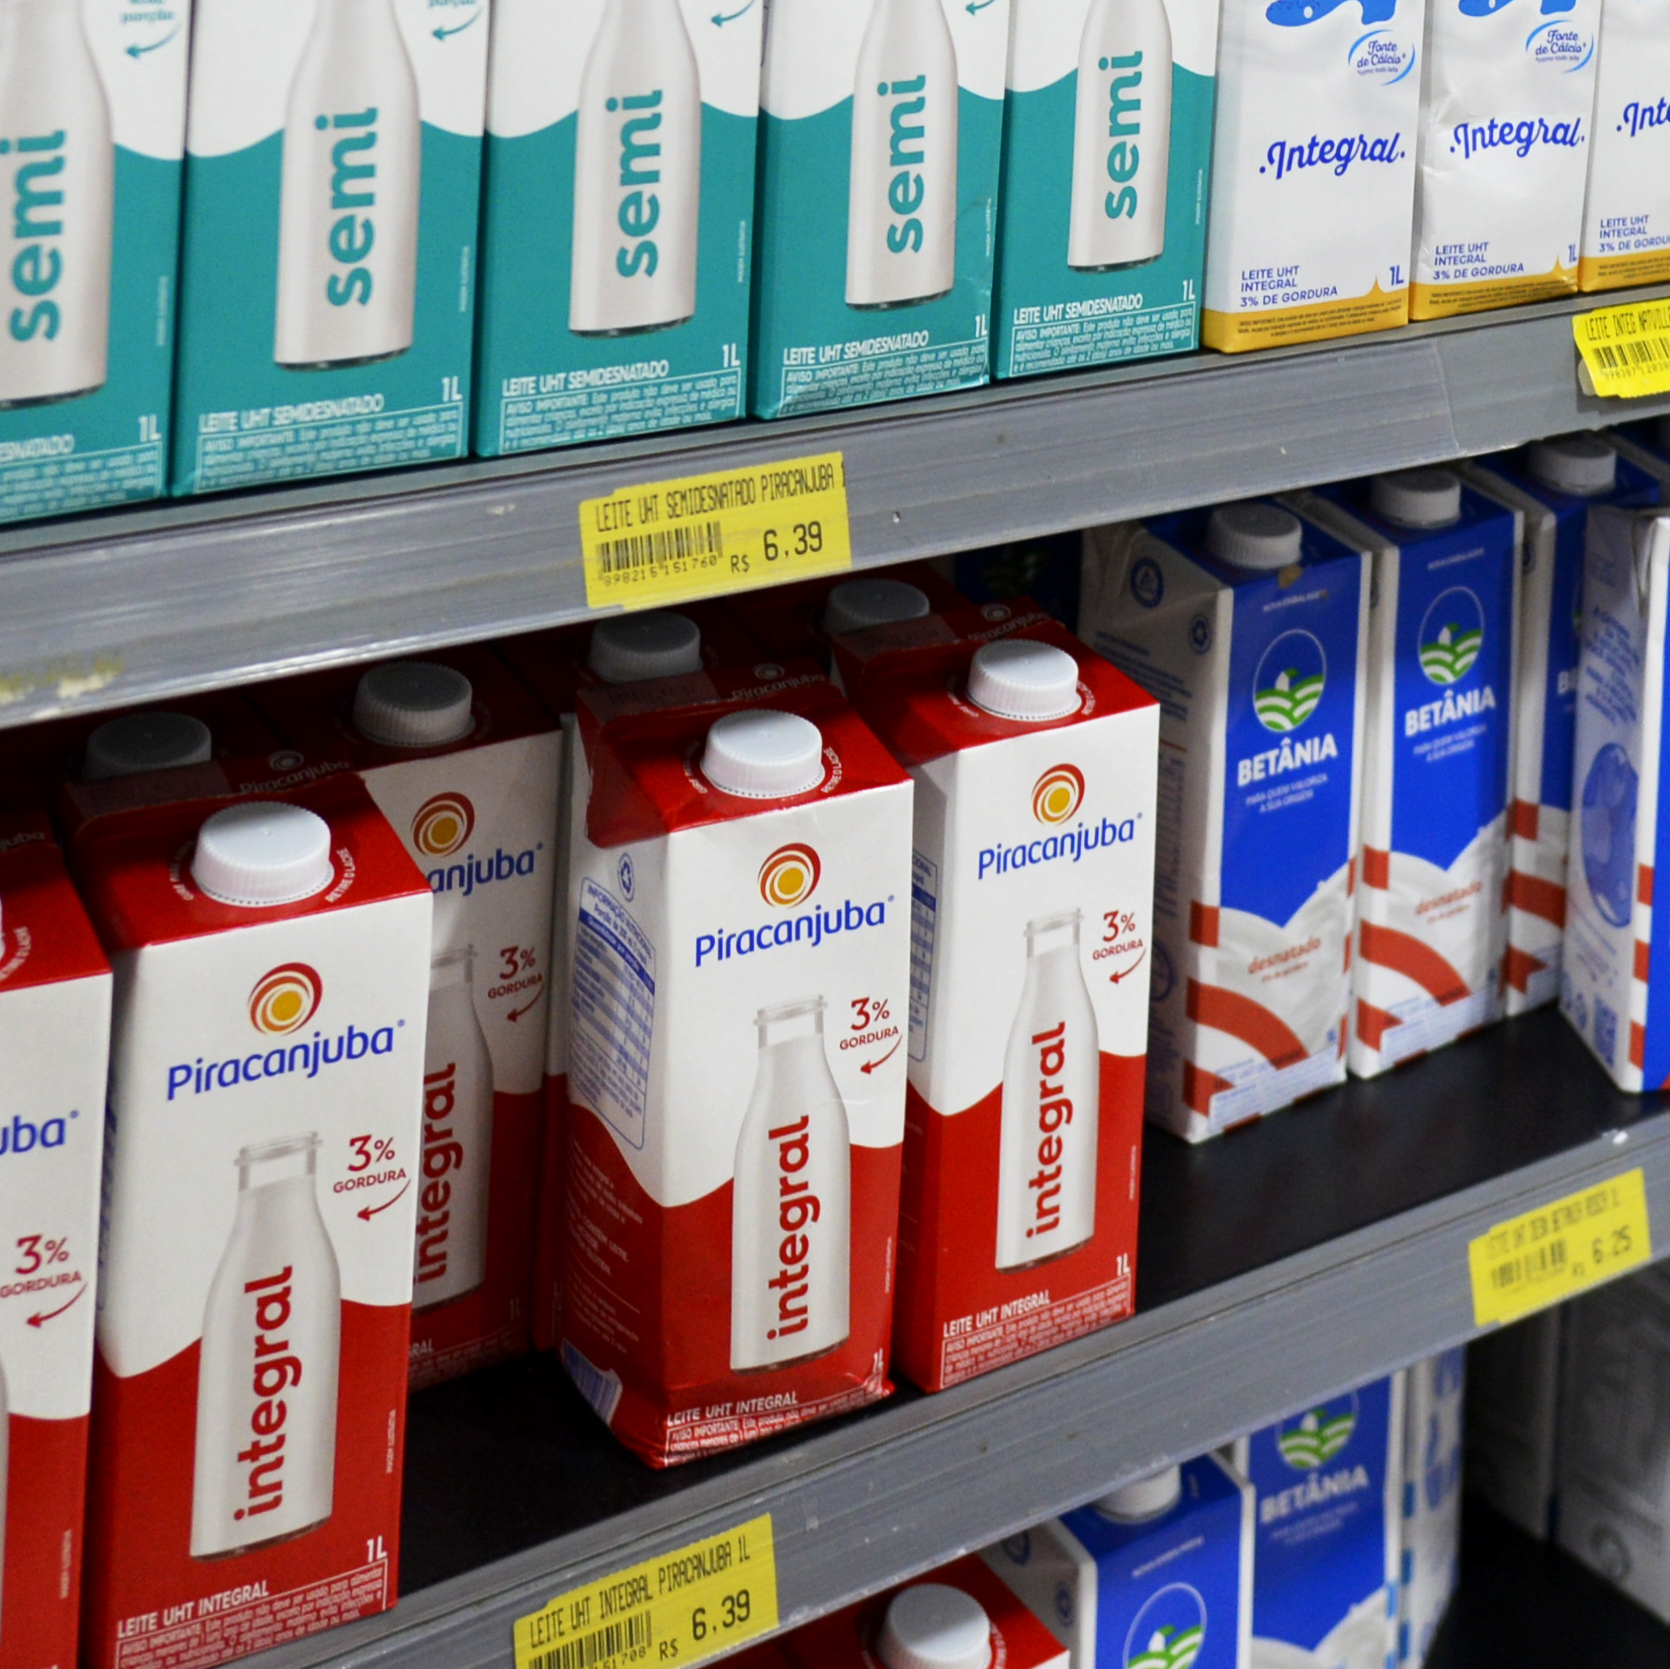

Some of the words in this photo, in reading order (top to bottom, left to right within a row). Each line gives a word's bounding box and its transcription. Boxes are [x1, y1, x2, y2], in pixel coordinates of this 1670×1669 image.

[1097, 50, 1143, 220] semi
[605, 88, 663, 279] semi
[877, 74, 927, 255] semi
[314, 106, 378, 307] semi
[1240, 277, 1299, 293] INTEGRAL
[1281, 285, 1339, 305] GORDURA
[1389, 265, 1405, 286] 1L
[1013, 305, 1041, 325] LEITE
[1042, 303, 1064, 324] UHT
[1065, 293, 1143, 322] SEMIDESNATADO
[1585, 315, 1610, 343] LEITE
[783, 343, 817, 366] LEITE
[843, 330, 929, 361] SEMIDESNATADO
[502, 375, 537, 397] LEITE
[568, 359, 669, 391] SEMIDESNATADO
[595, 496, 634, 533] LEITE
[638, 491, 662, 524] UHT
[666, 478, 755, 521] SEMIDESNATADO
[760, 467, 836, 503] PIRACANJUBA
[762, 520, 823, 562] 6.39
[1405, 685, 1497, 738] BETÂNIA
[1236, 733, 1338, 787] BETÂNIA
[976, 818, 1136, 881] Piracanjuba
[693, 900, 887, 969] Piracanjuba
[1100, 909, 1138, 943] 3%
[497, 944, 537, 981] 3%
[1091, 935, 1145, 964] GORDURA
[487, 972, 543, 1000] GORDURA
[849, 996, 891, 1032] 3%
[838, 1022, 900, 1052] GORDURA
[164, 1022, 396, 1103] Piracanjuba
[1024, 1019, 1074, 1241] integral
[346, 1134, 396, 1173] 3%
[332, 1165, 408, 1195] GORDURA
[766, 1113, 821, 1341] integral
[15, 1234, 69, 1275] 3%
[1115, 1252, 1130, 1279] 1L
[942, 1316, 974, 1339] LEITE
[976, 1310, 1000, 1330] UHT
[1000, 1288, 1052, 1320] INTEGRAL
[231, 1264, 303, 1522] integral
[735, 1389, 799, 1417] INTEGRAL
[1259, 1465, 1370, 1525] BETÂNIA
[365, 1534, 388, 1563] 1L
[117, 1610, 158, 1639] LEITE
[163, 1600, 195, 1627] UHT
[197, 1579, 270, 1617] INTEGRAL
[529, 1612, 564, 1649] LEITE
[569, 1603, 596, 1634] UHT
[598, 1580, 653, 1624] INTEGRAL
[657, 1549, 733, 1604] PIRACANJUBA
[691, 1587, 752, 1641] 6.39
